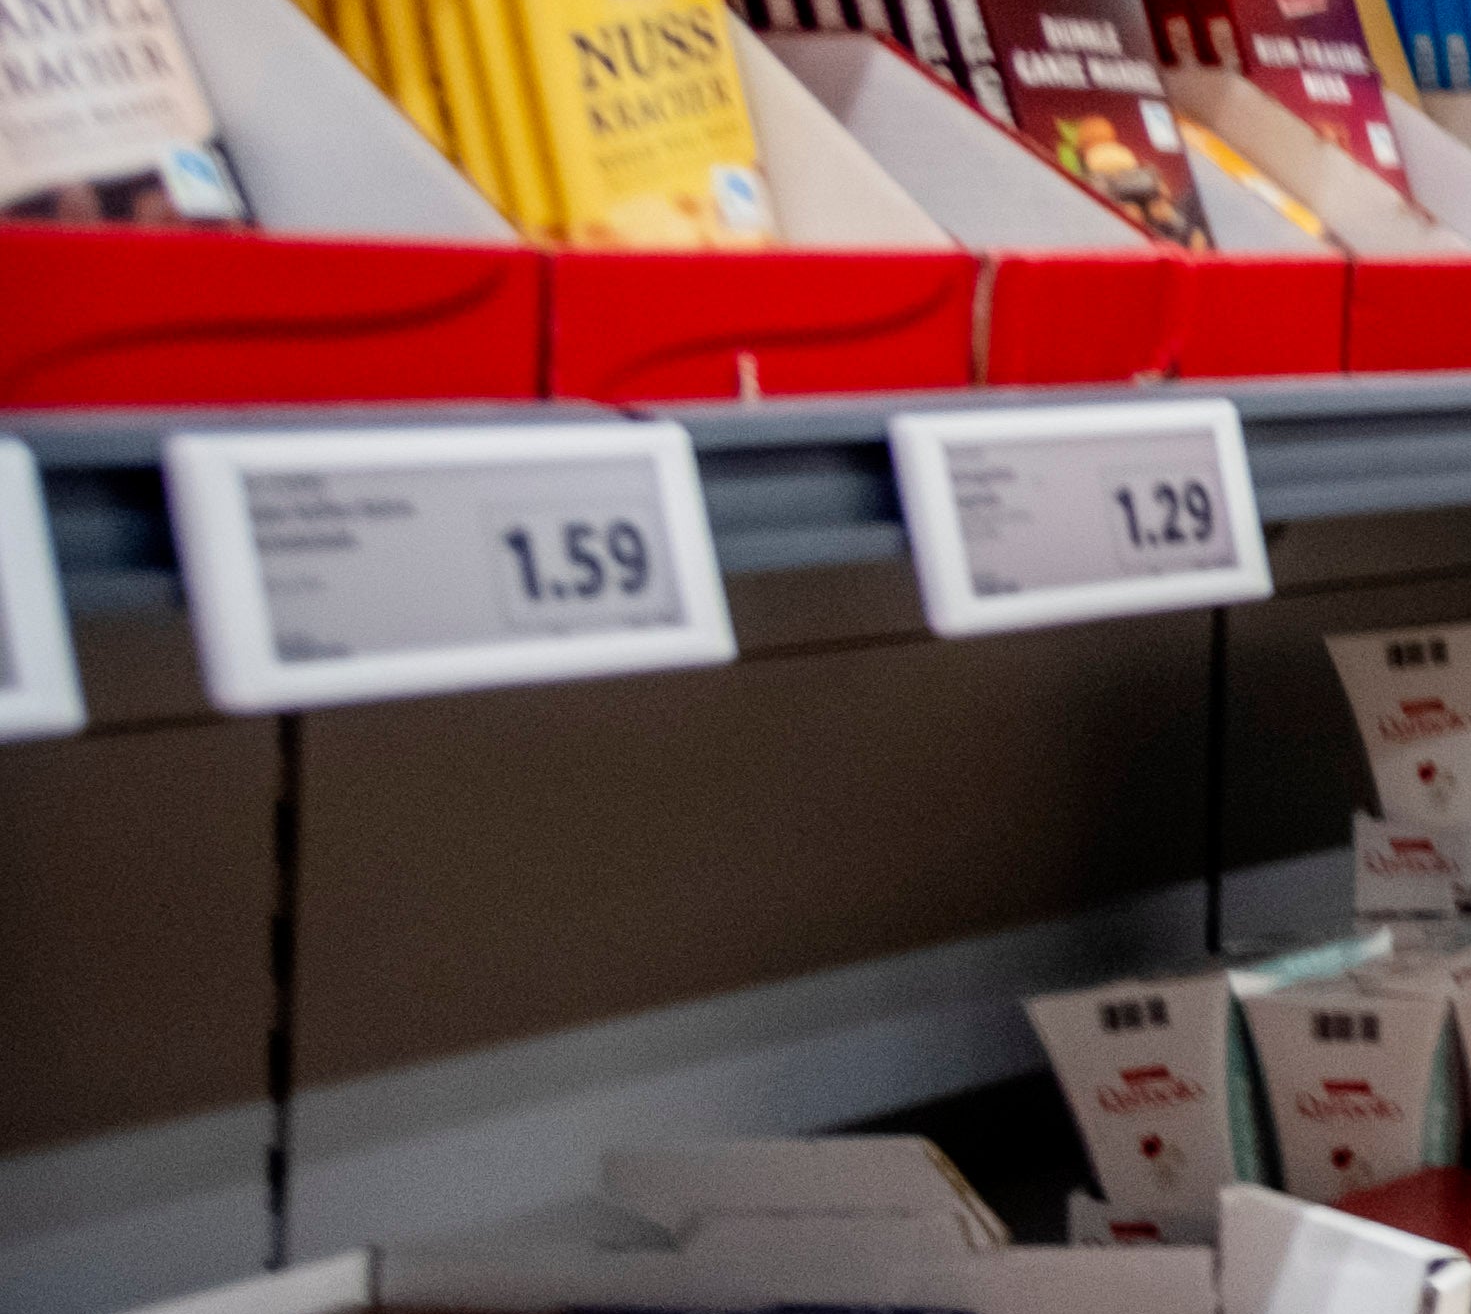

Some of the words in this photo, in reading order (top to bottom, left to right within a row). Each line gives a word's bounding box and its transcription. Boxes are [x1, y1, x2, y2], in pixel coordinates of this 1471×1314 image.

[573, 7, 722, 92] NUSS
[1114, 480, 1214, 549] 1.29
[503, 518, 650, 603] 1.59
